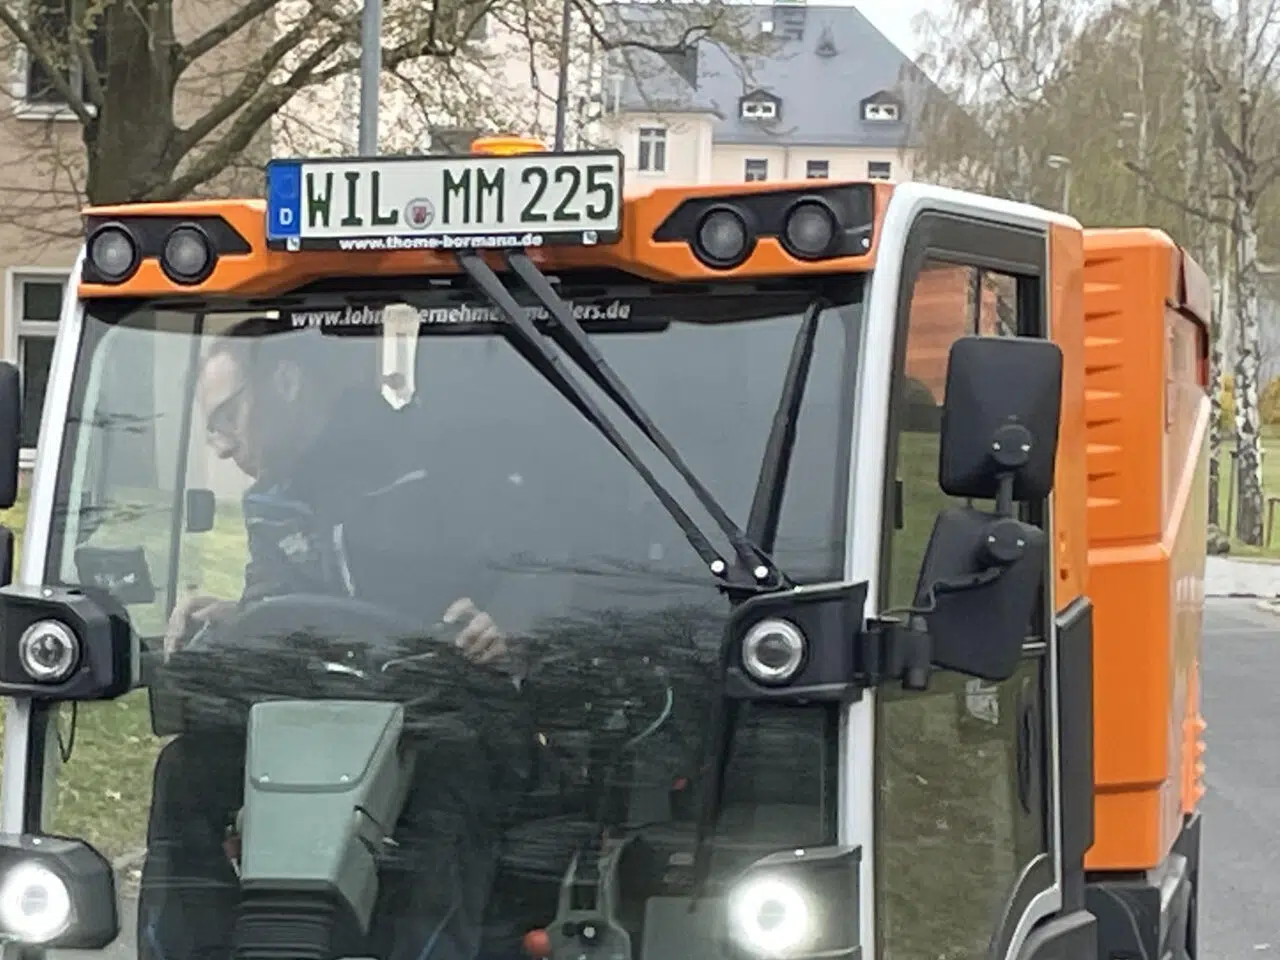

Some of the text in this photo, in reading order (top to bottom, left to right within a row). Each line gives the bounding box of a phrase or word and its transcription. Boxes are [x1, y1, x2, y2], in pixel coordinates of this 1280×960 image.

[306, 165, 614, 228] WIL MM 225
